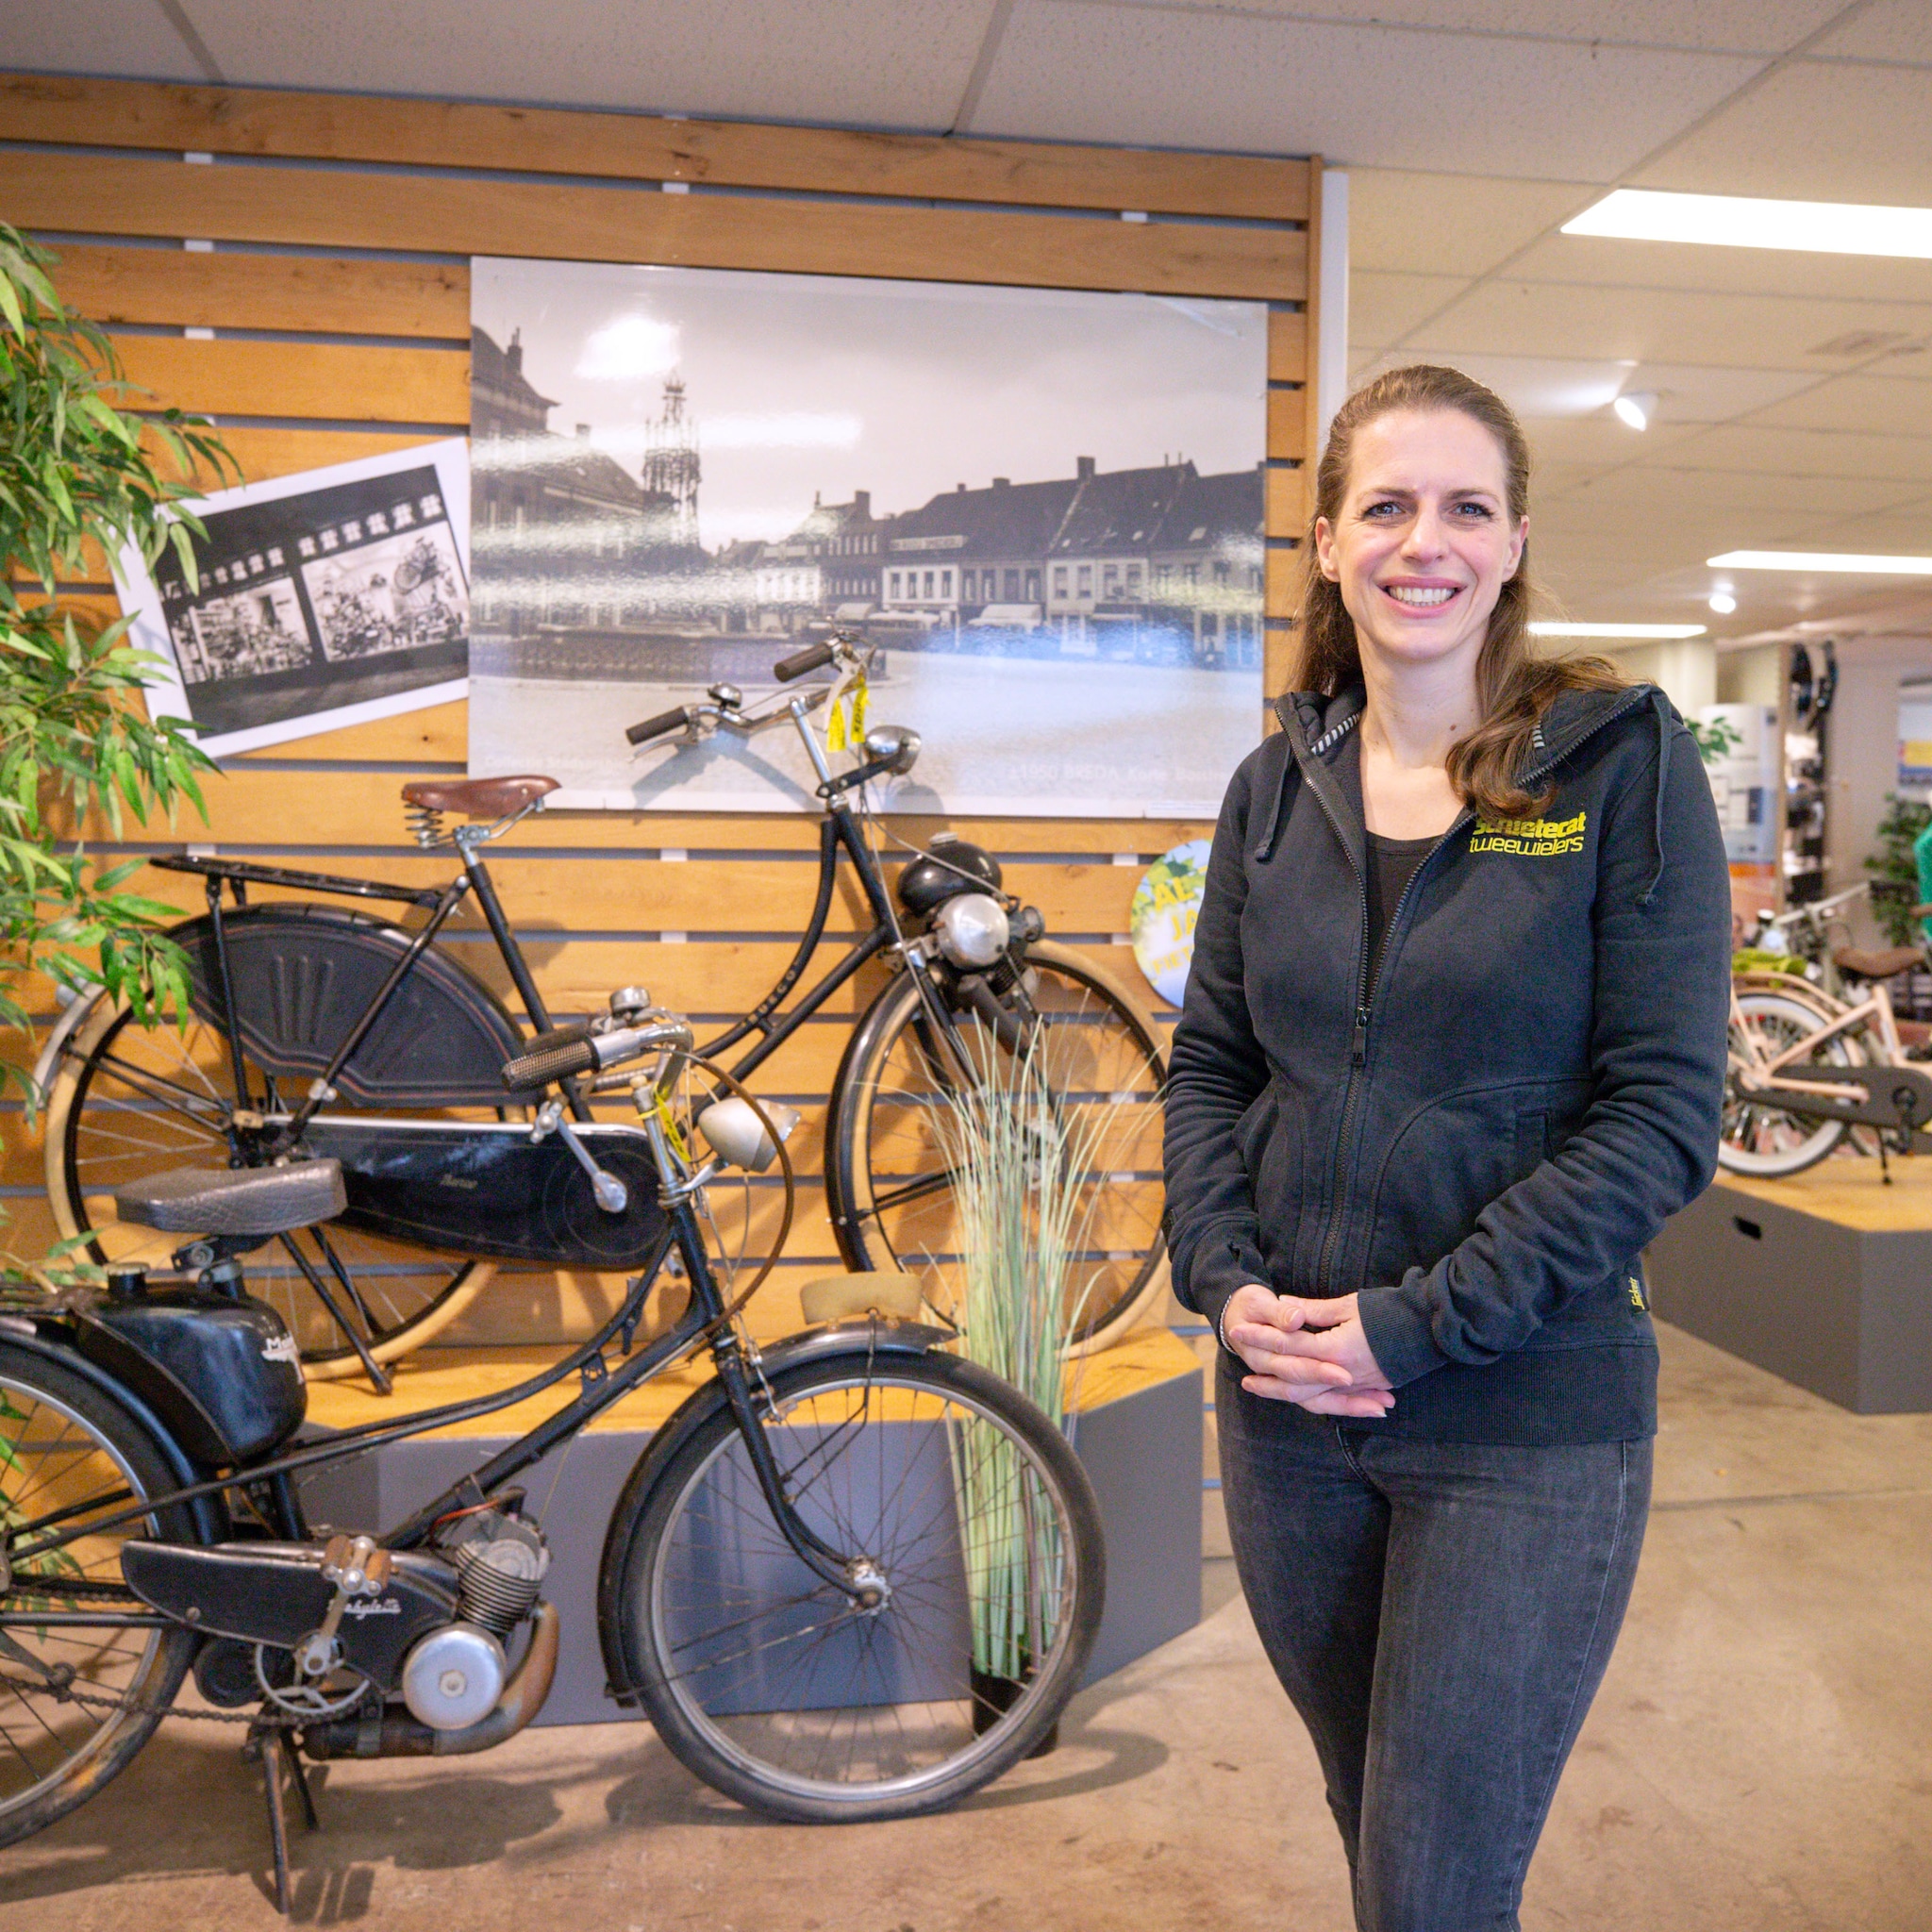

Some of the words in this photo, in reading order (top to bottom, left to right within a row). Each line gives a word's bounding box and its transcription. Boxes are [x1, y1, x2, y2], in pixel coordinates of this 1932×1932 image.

[1469, 836, 1585, 857] tweewielers
[1155, 876, 1196, 912] AL
[1172, 908, 1198, 942] JA
[1152, 943, 1194, 975] FIET
